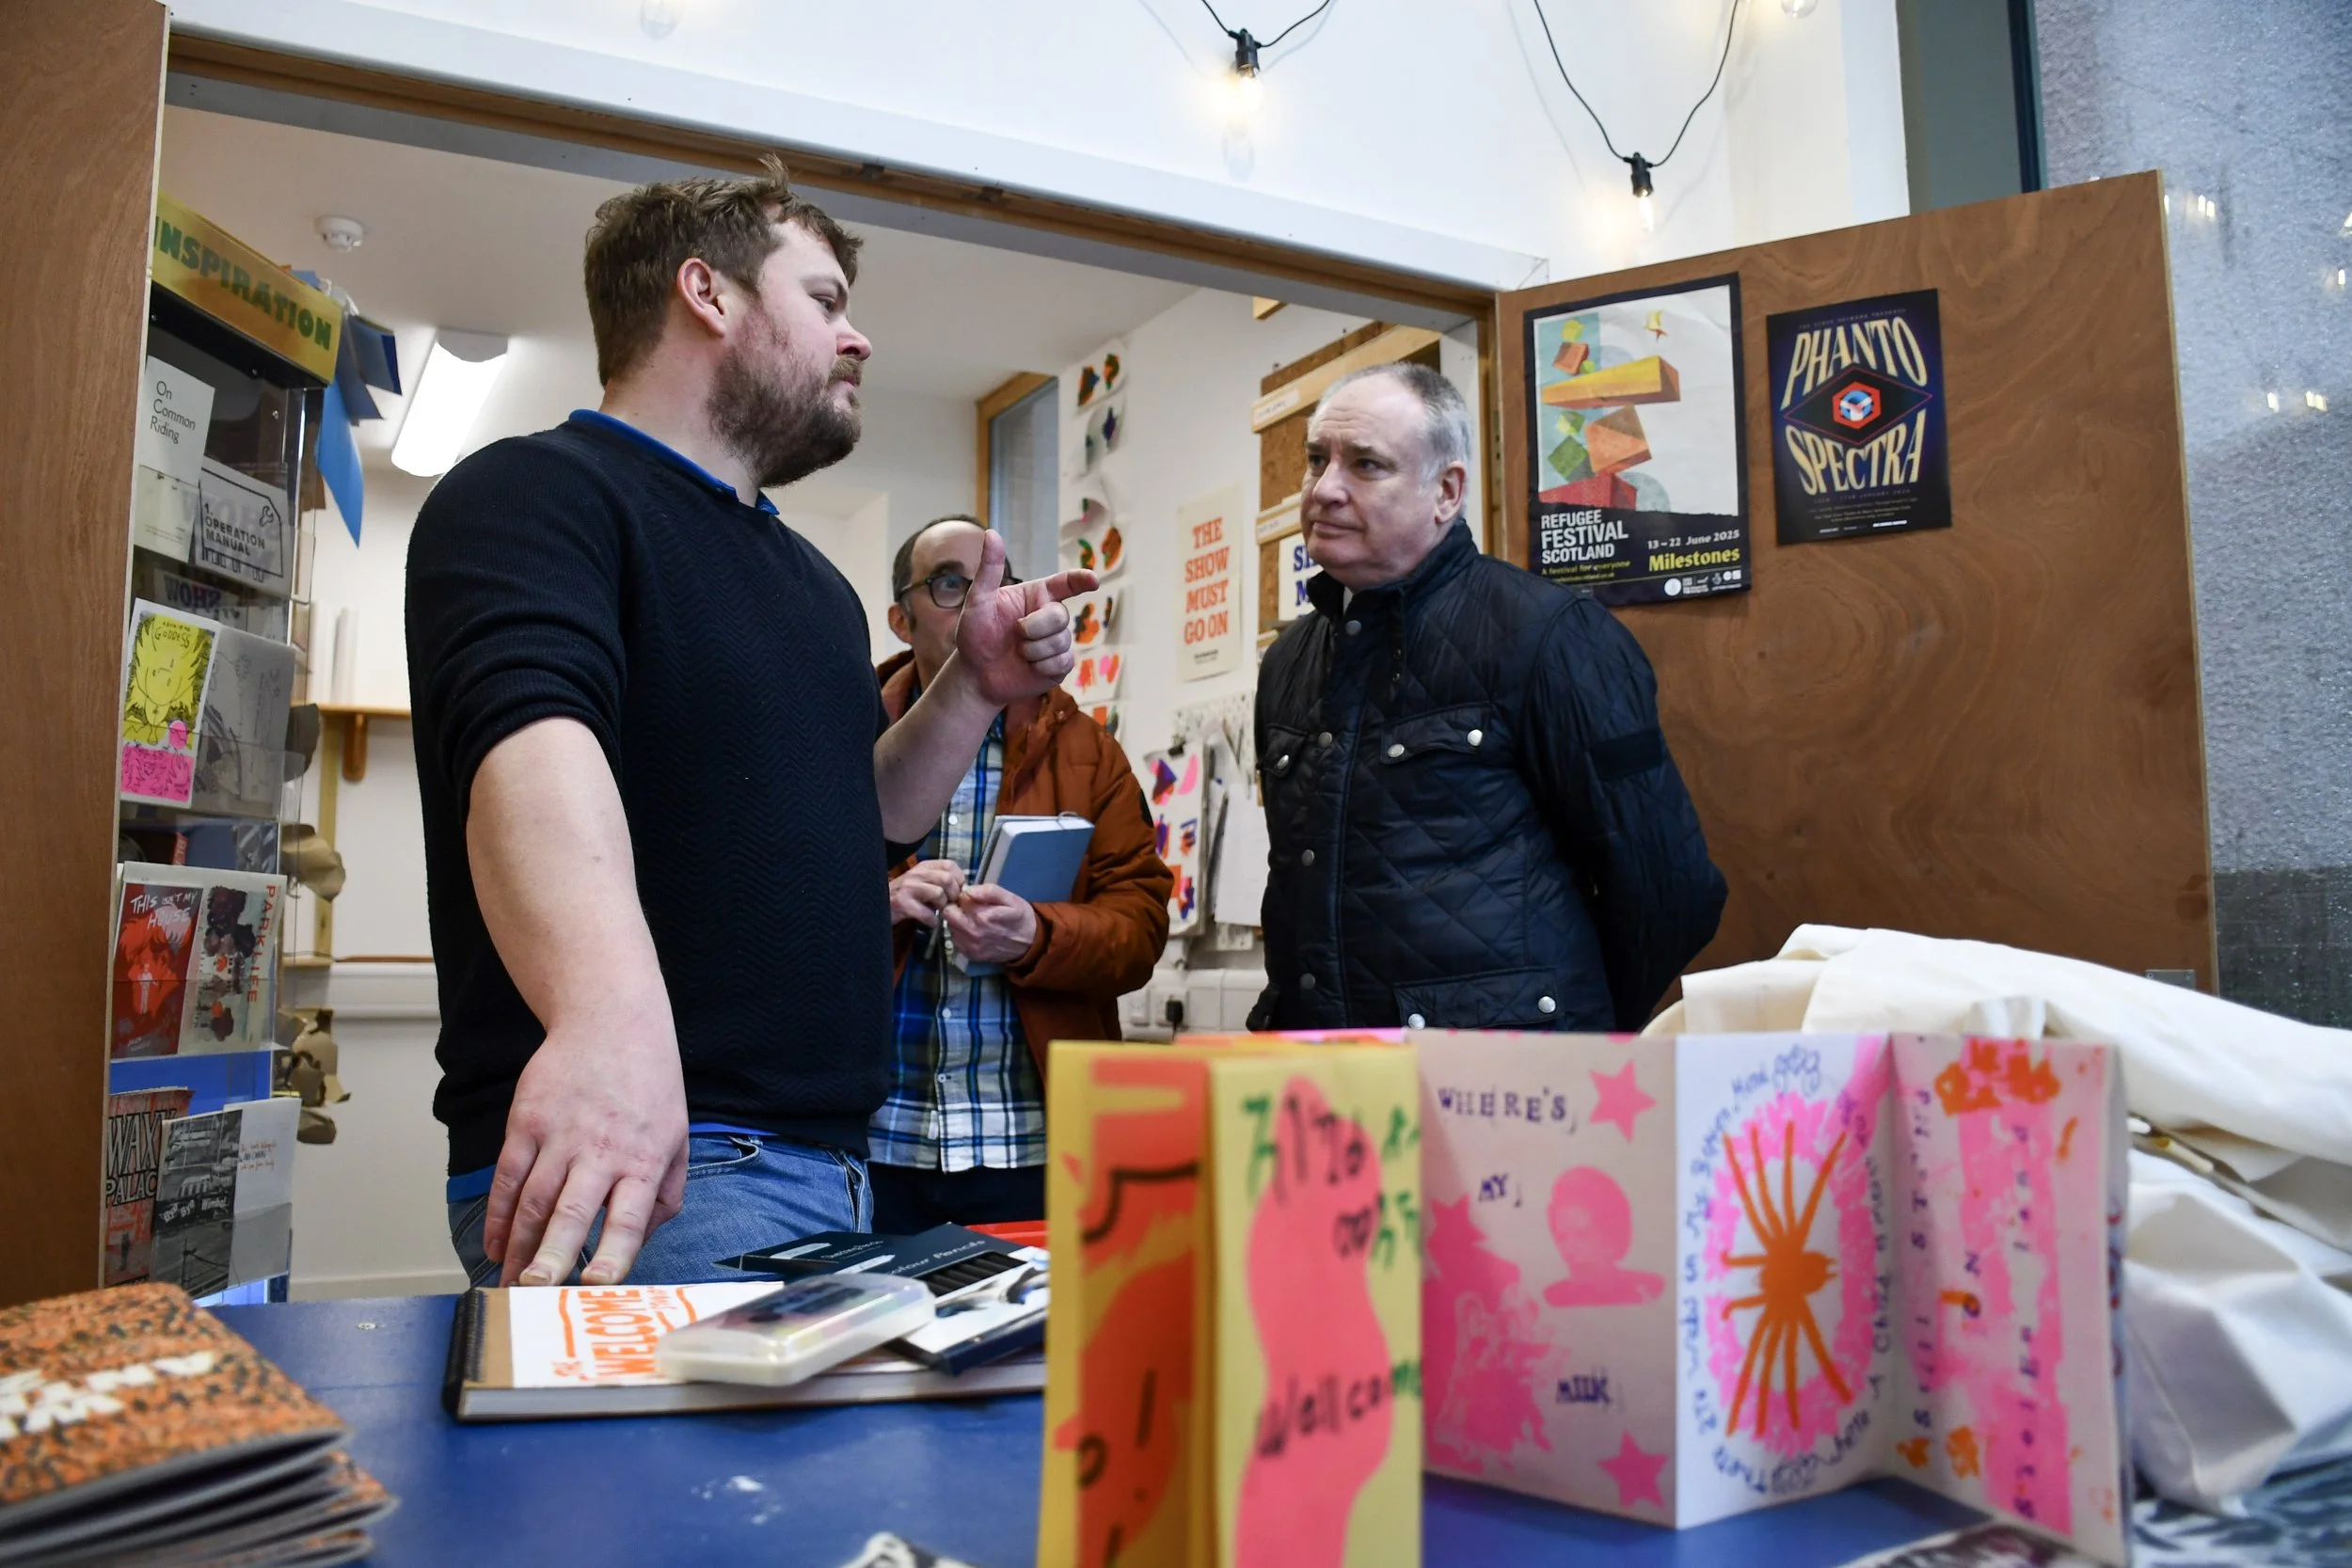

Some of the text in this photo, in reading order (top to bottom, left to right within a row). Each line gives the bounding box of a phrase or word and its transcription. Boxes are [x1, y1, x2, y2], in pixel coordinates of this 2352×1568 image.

[153, 216, 332, 351] INSPIRATION
[1780, 316, 1928, 411] PHANTO
[156, 380, 172, 400] On
[150, 416, 180, 445] Riding
[153, 398, 196, 431] Common
[1786, 408, 1927, 496] SPECTRA
[205, 517, 265, 550] OPERATION
[1193, 517, 1223, 549] THE
[1541, 509, 1602, 530] REFUGEE
[1541, 520, 1629, 549] FESTIVAL
[205, 528, 251, 557] MANUAL
[1542, 543, 1615, 564] SCOTLAND
[1686, 535, 1711, 546] June
[1184, 546, 1231, 583] SHOW
[1649, 548, 1740, 572] Milestones
[1186, 578, 1229, 613] MUST
[1184, 610, 1229, 645] GO ON
[130, 894, 159, 914] THIS
[147, 907, 191, 930] HOUSE
[107, 1108, 177, 1177] WAX
[105, 1171, 157, 1206] PALAC
[932, 1240, 986, 1259] Pencils
[577, 1289, 660, 1377] WELCOME
